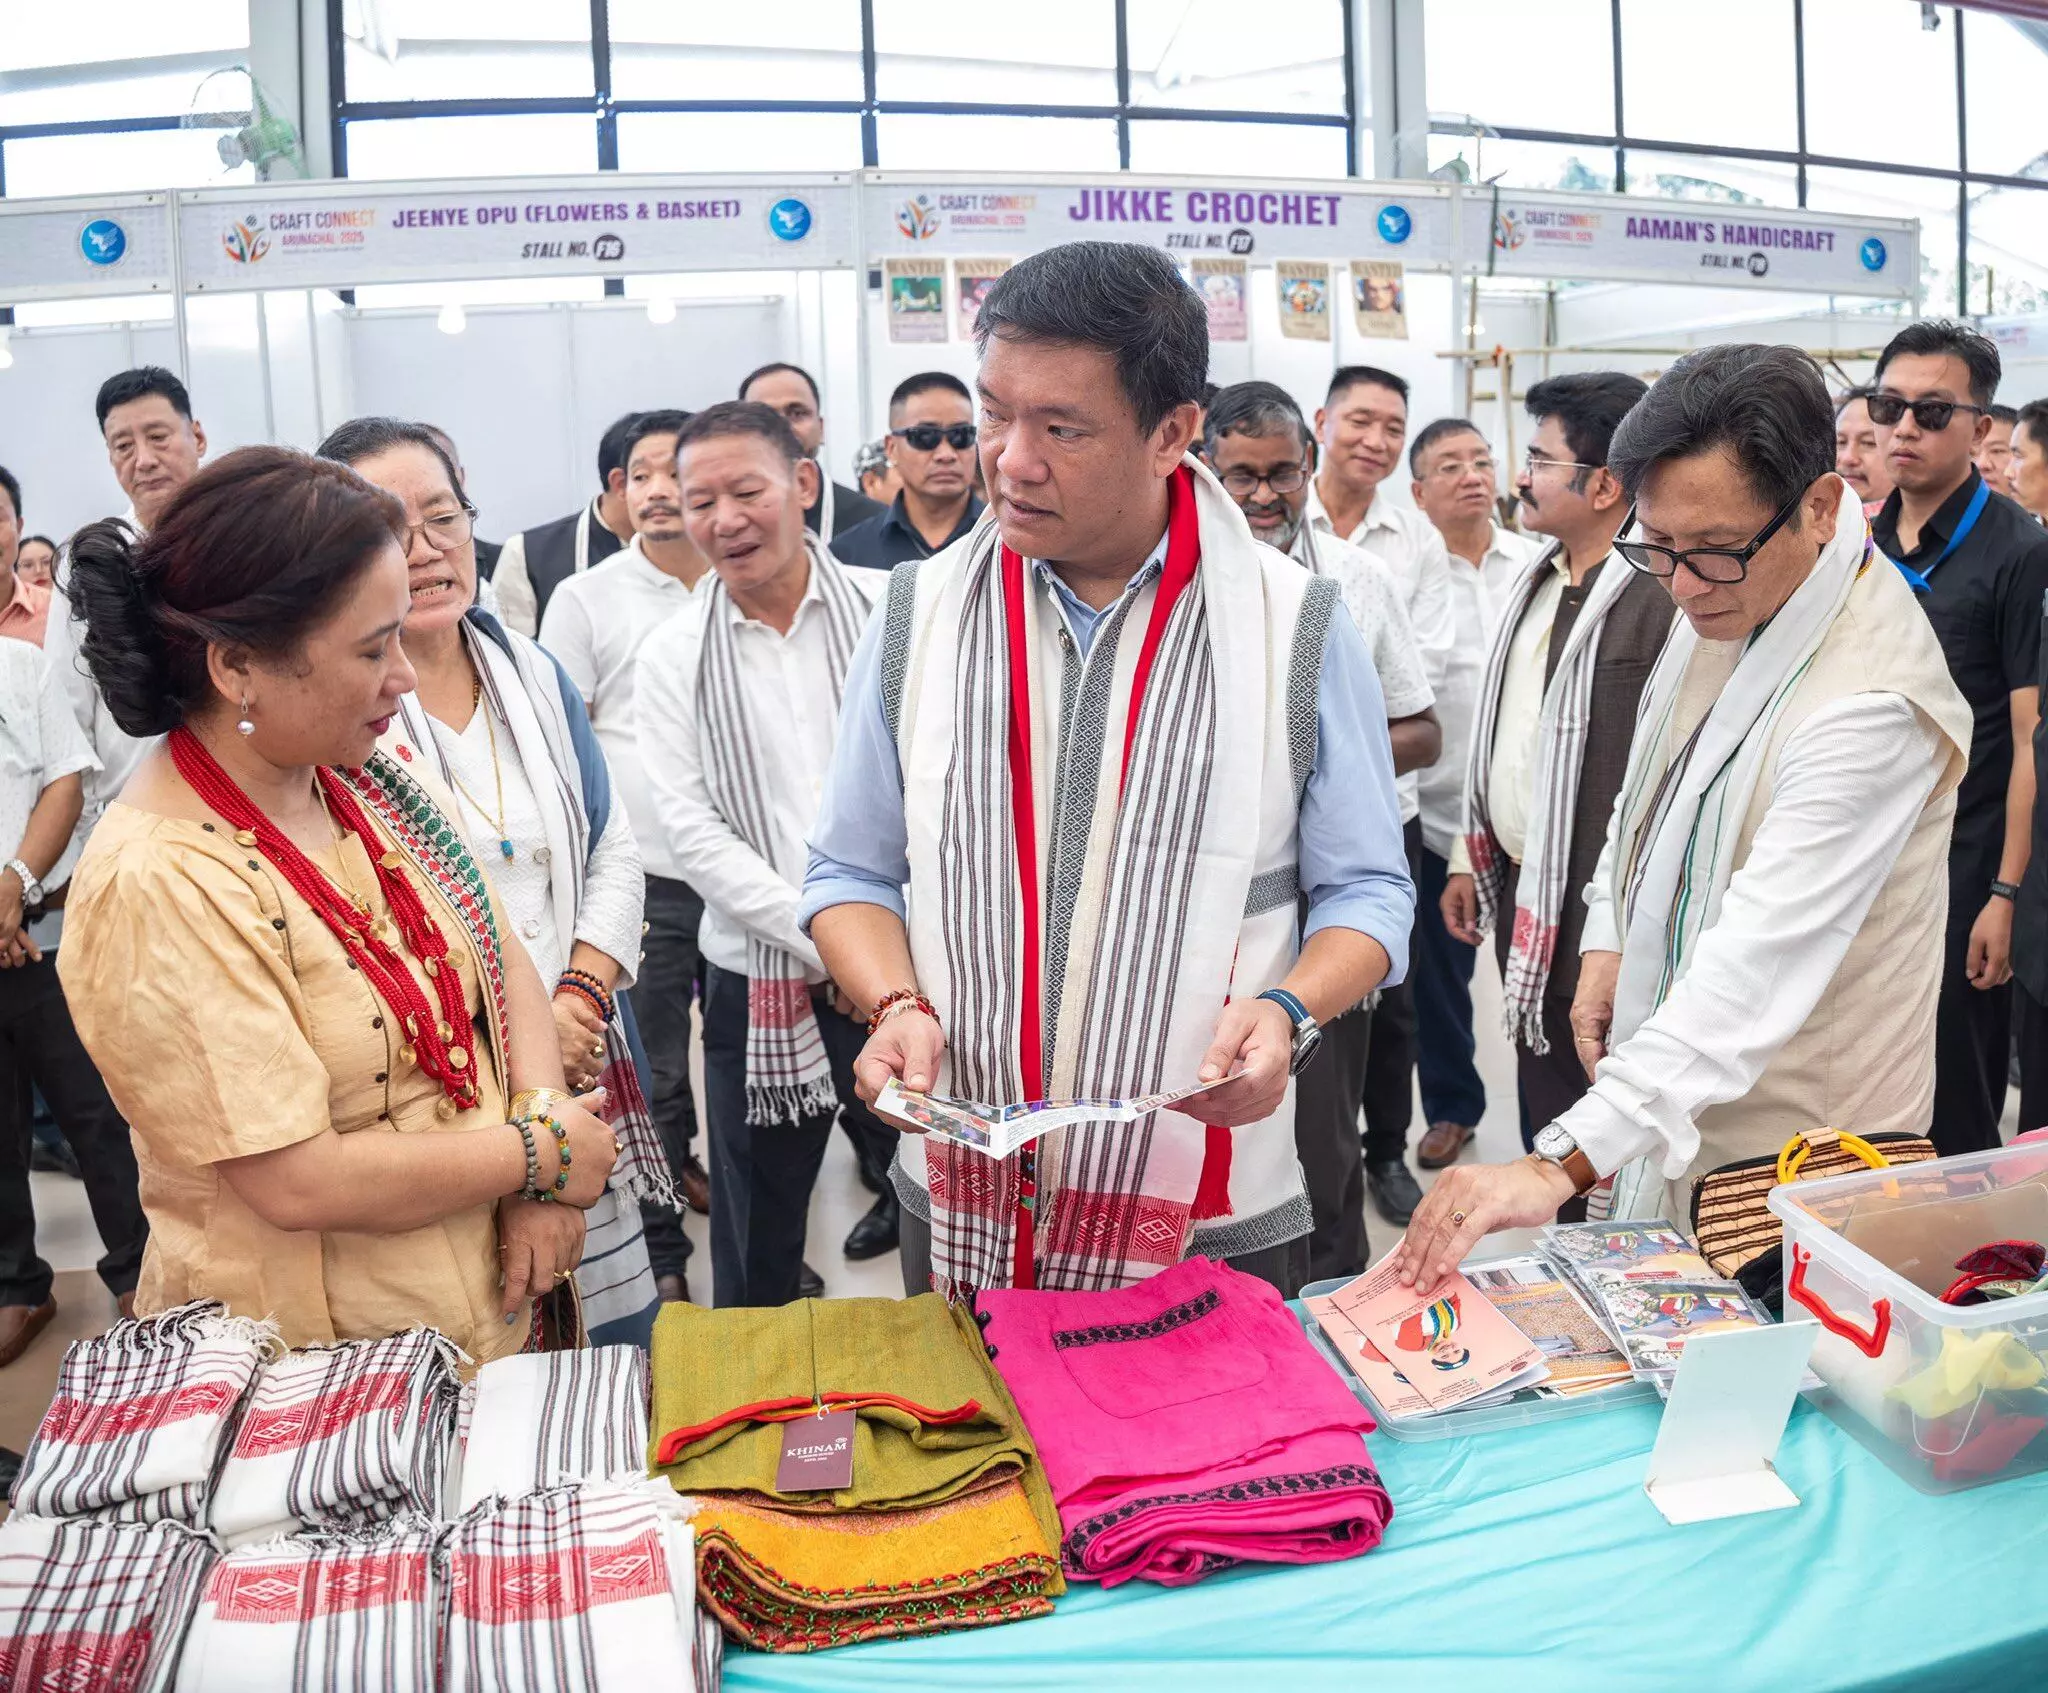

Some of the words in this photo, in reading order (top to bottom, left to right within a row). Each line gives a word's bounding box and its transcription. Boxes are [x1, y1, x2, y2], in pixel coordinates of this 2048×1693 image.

[939, 194, 978, 211] CRAFT
[981, 194, 1037, 211] CONNECT
[1068, 188, 1174, 222] JIKKE
[1187, 191, 1341, 227] CROCHET
[270, 212, 312, 231] CRAFT
[315, 208, 375, 229] CONNECT
[392, 207, 469, 229] JEENYE
[476, 206, 517, 225] OPU
[525, 202, 628, 223] (FLOWERS
[636, 202, 649, 219] &
[657, 200, 741, 219] BASKET)
[1165, 234, 1201, 249] STALL
[1205, 234, 1224, 248] NO.
[1625, 216, 1715, 243] AAMAN'S
[1723, 224, 1835, 252] HANDICRAFT
[521, 241, 563, 259] STALL
[567, 241, 590, 258] NO.
[1701, 254, 1728, 268] STALL
[786, 1442, 847, 1457] KHINAM
